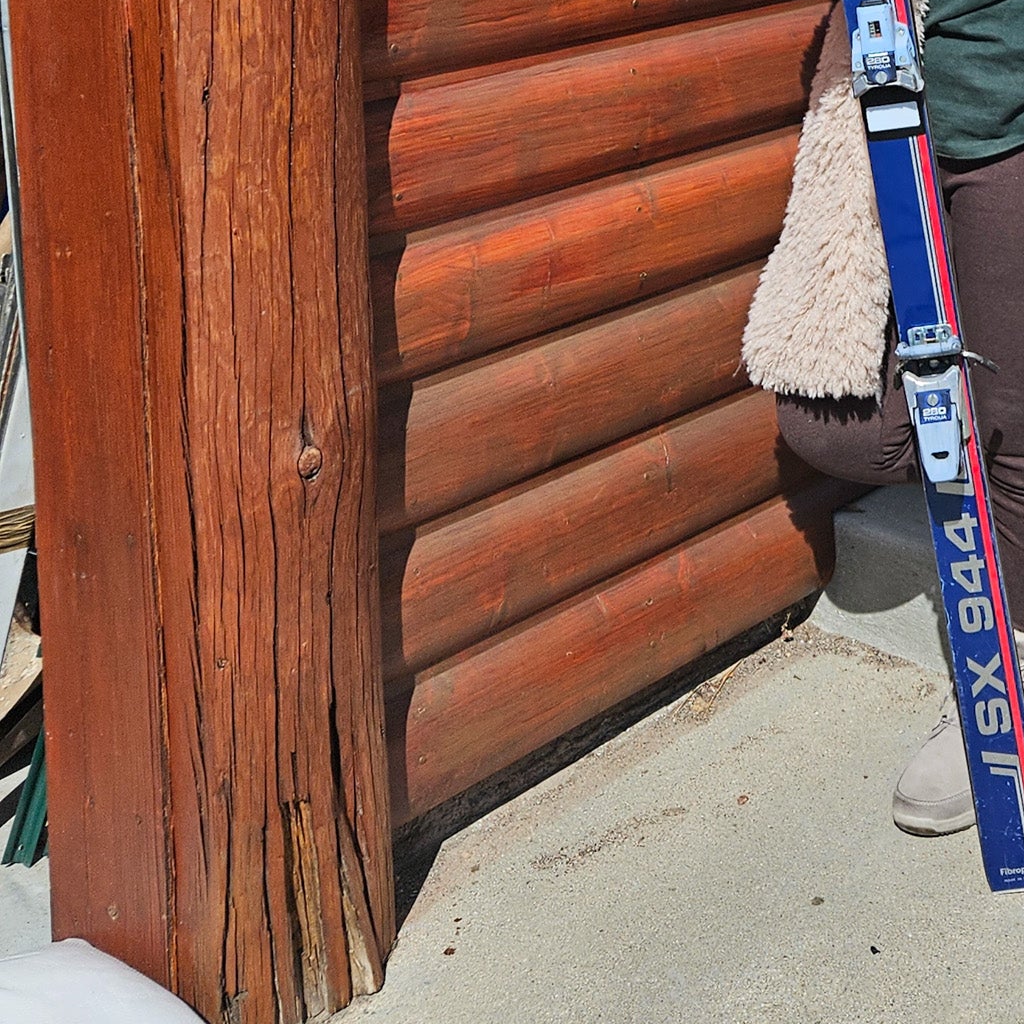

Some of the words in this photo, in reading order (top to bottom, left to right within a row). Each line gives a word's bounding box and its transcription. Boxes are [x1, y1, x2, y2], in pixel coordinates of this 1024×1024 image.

[922, 406, 947, 418] 280
[945, 512, 995, 634] 944
[967, 651, 1013, 736] SX
